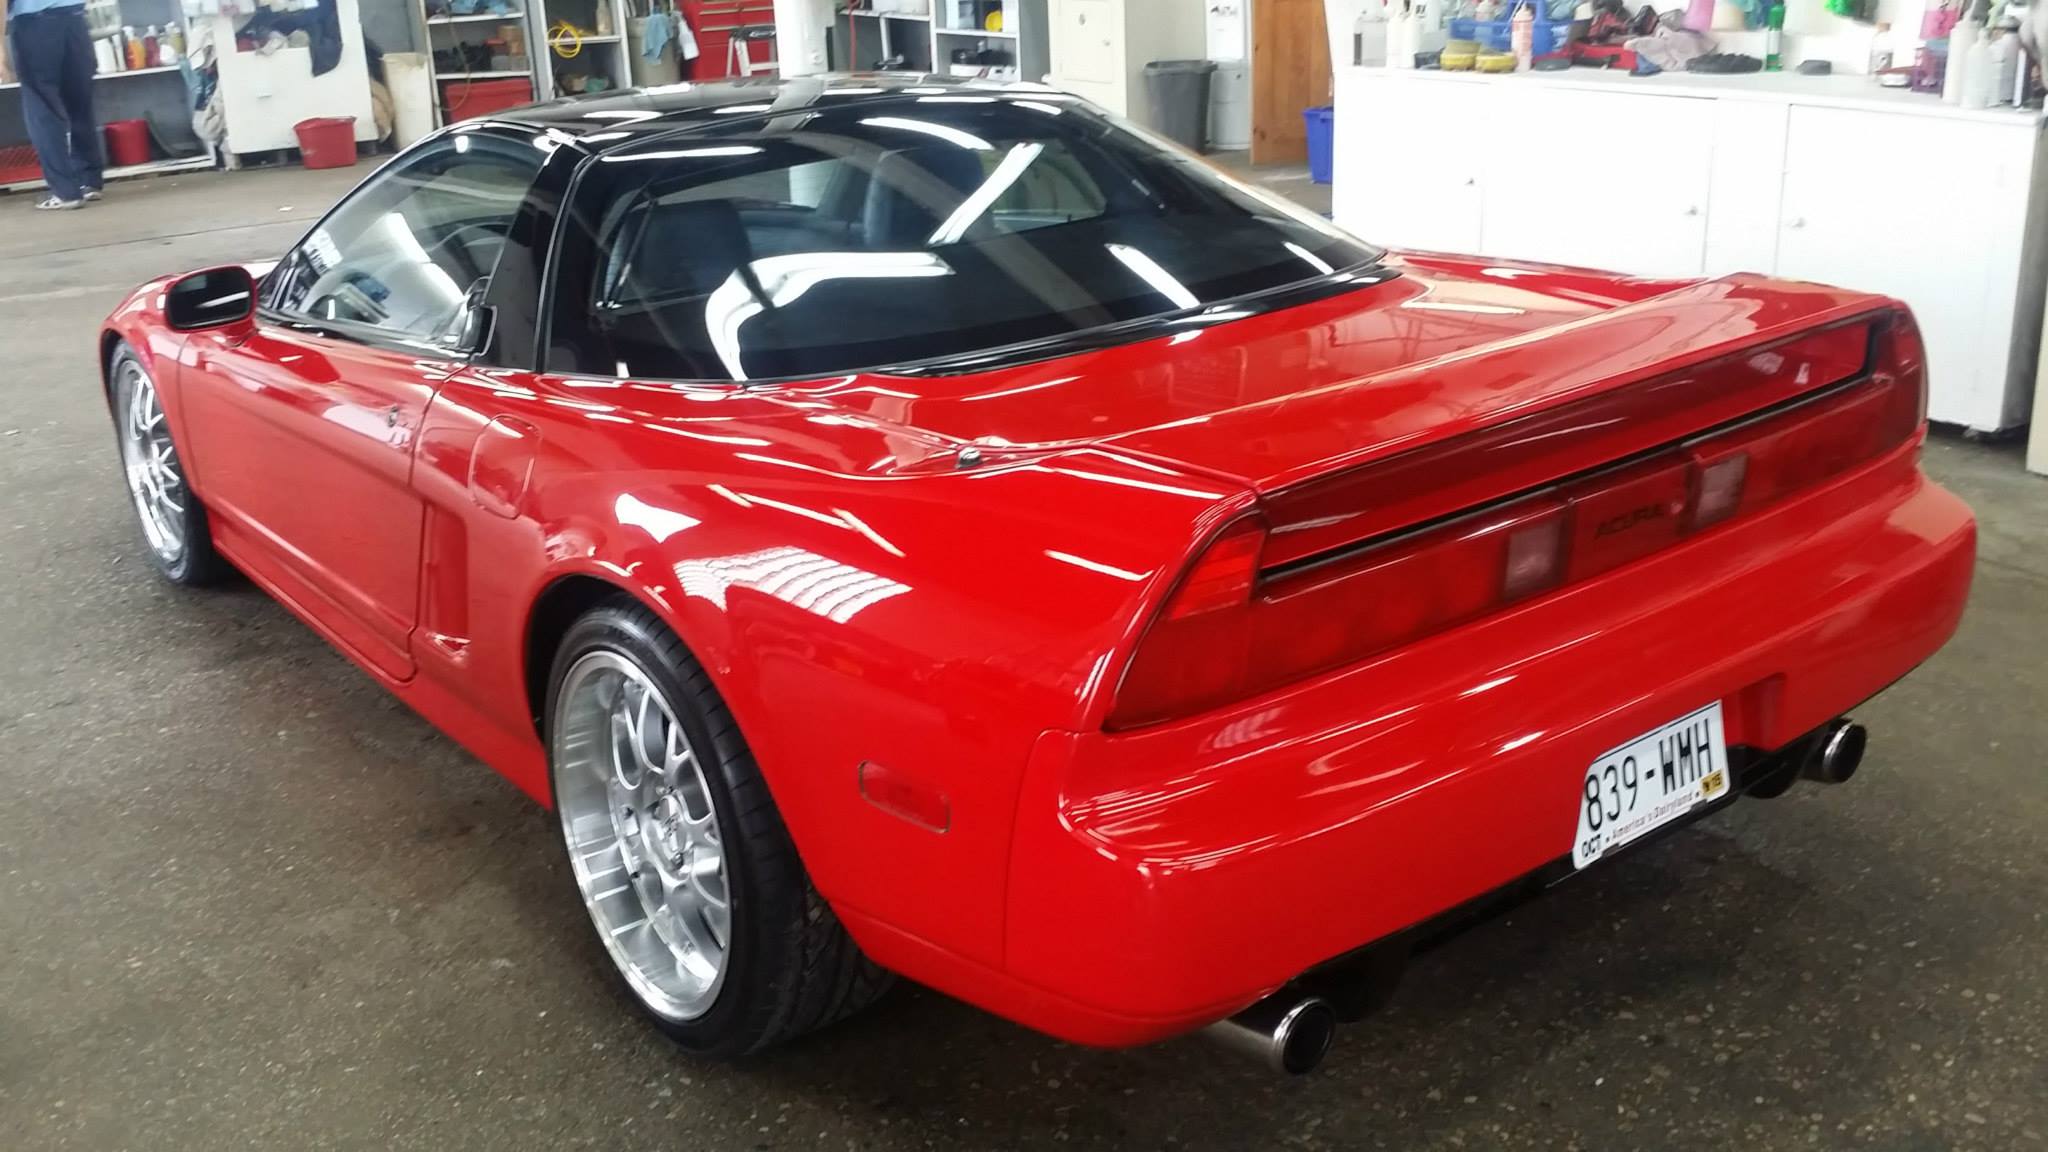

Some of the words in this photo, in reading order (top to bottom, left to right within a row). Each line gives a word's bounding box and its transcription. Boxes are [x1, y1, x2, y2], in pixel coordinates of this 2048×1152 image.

[1594, 504, 1665, 539] ACURA
[1585, 718, 1712, 831] 839-WMH
[1582, 834, 1602, 858] OCT
